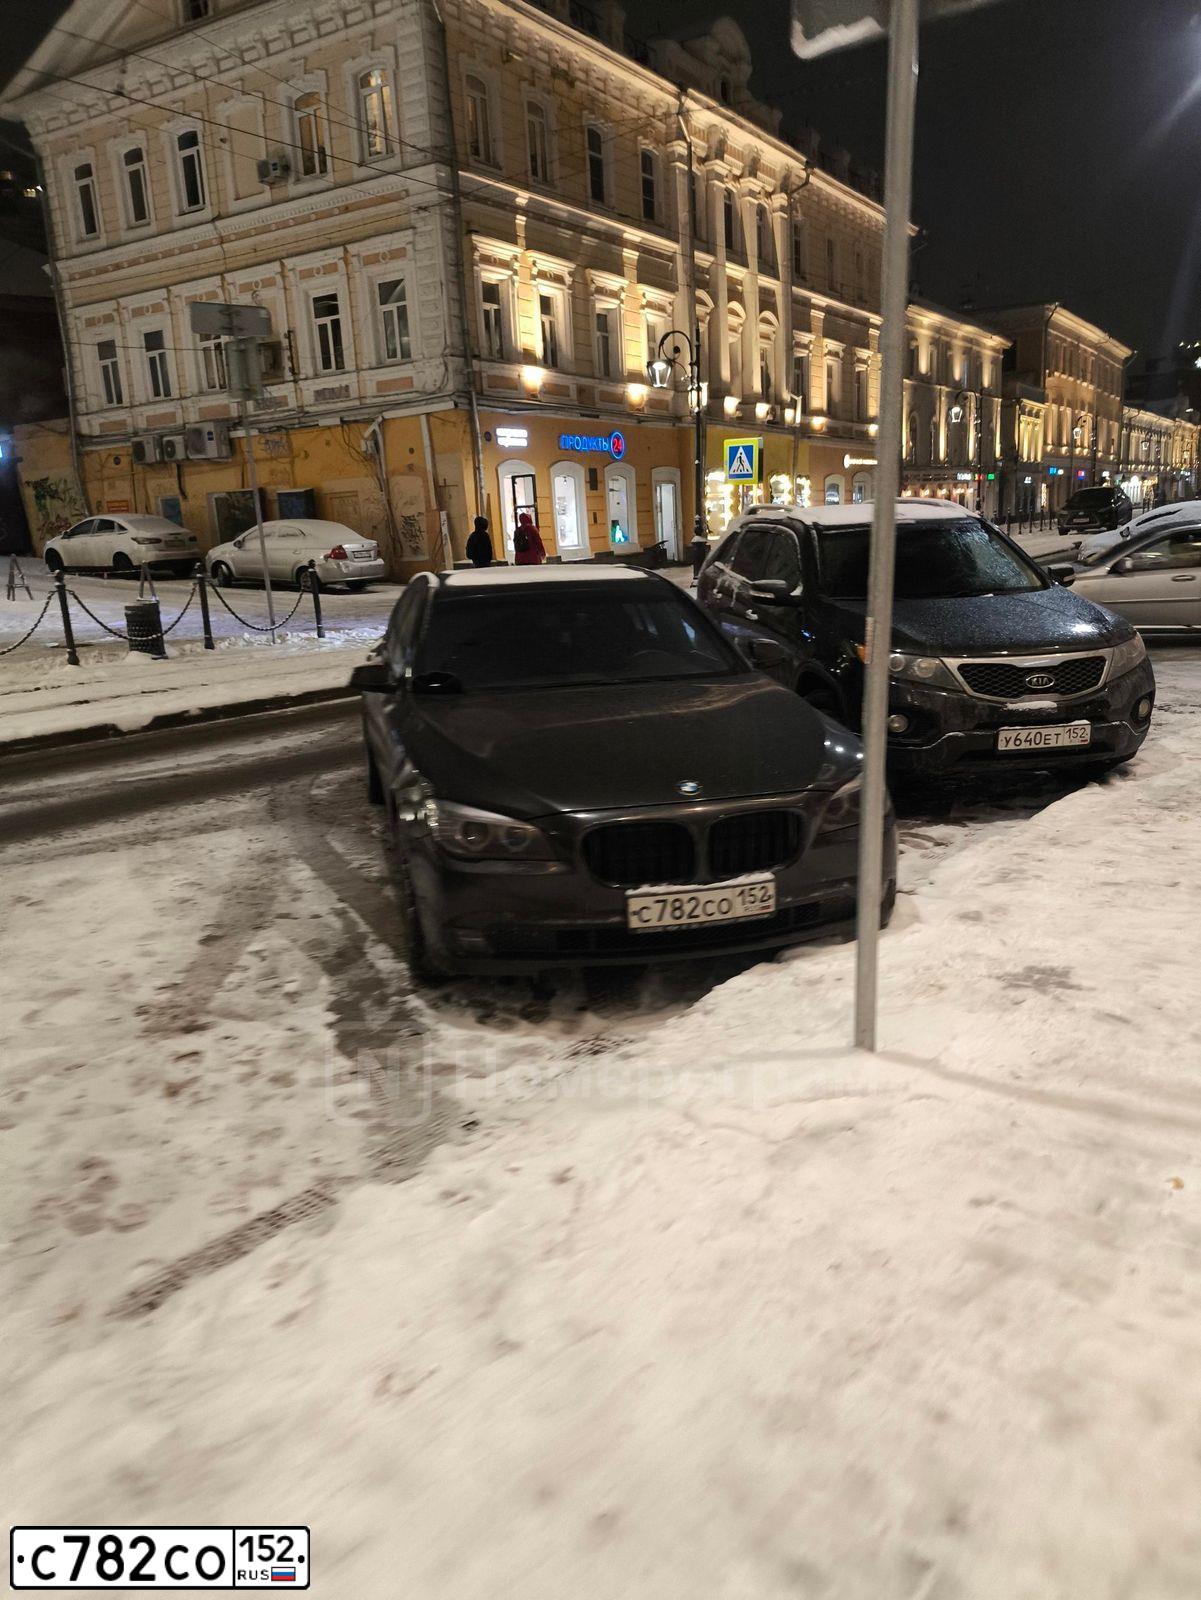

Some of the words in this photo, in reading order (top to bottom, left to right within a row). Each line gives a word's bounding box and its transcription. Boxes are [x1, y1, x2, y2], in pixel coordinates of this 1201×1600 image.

[560, 434, 610, 452] ПРОДУКТЫ
[613, 436, 623, 453] 24
[1031, 677, 1050, 686] KIA
[1004, 731, 1062, 748] У640ЕТ
[1065, 727, 1087, 740] 152
[636, 896, 734, 924] С782СО
[737, 885, 772, 906] 152
